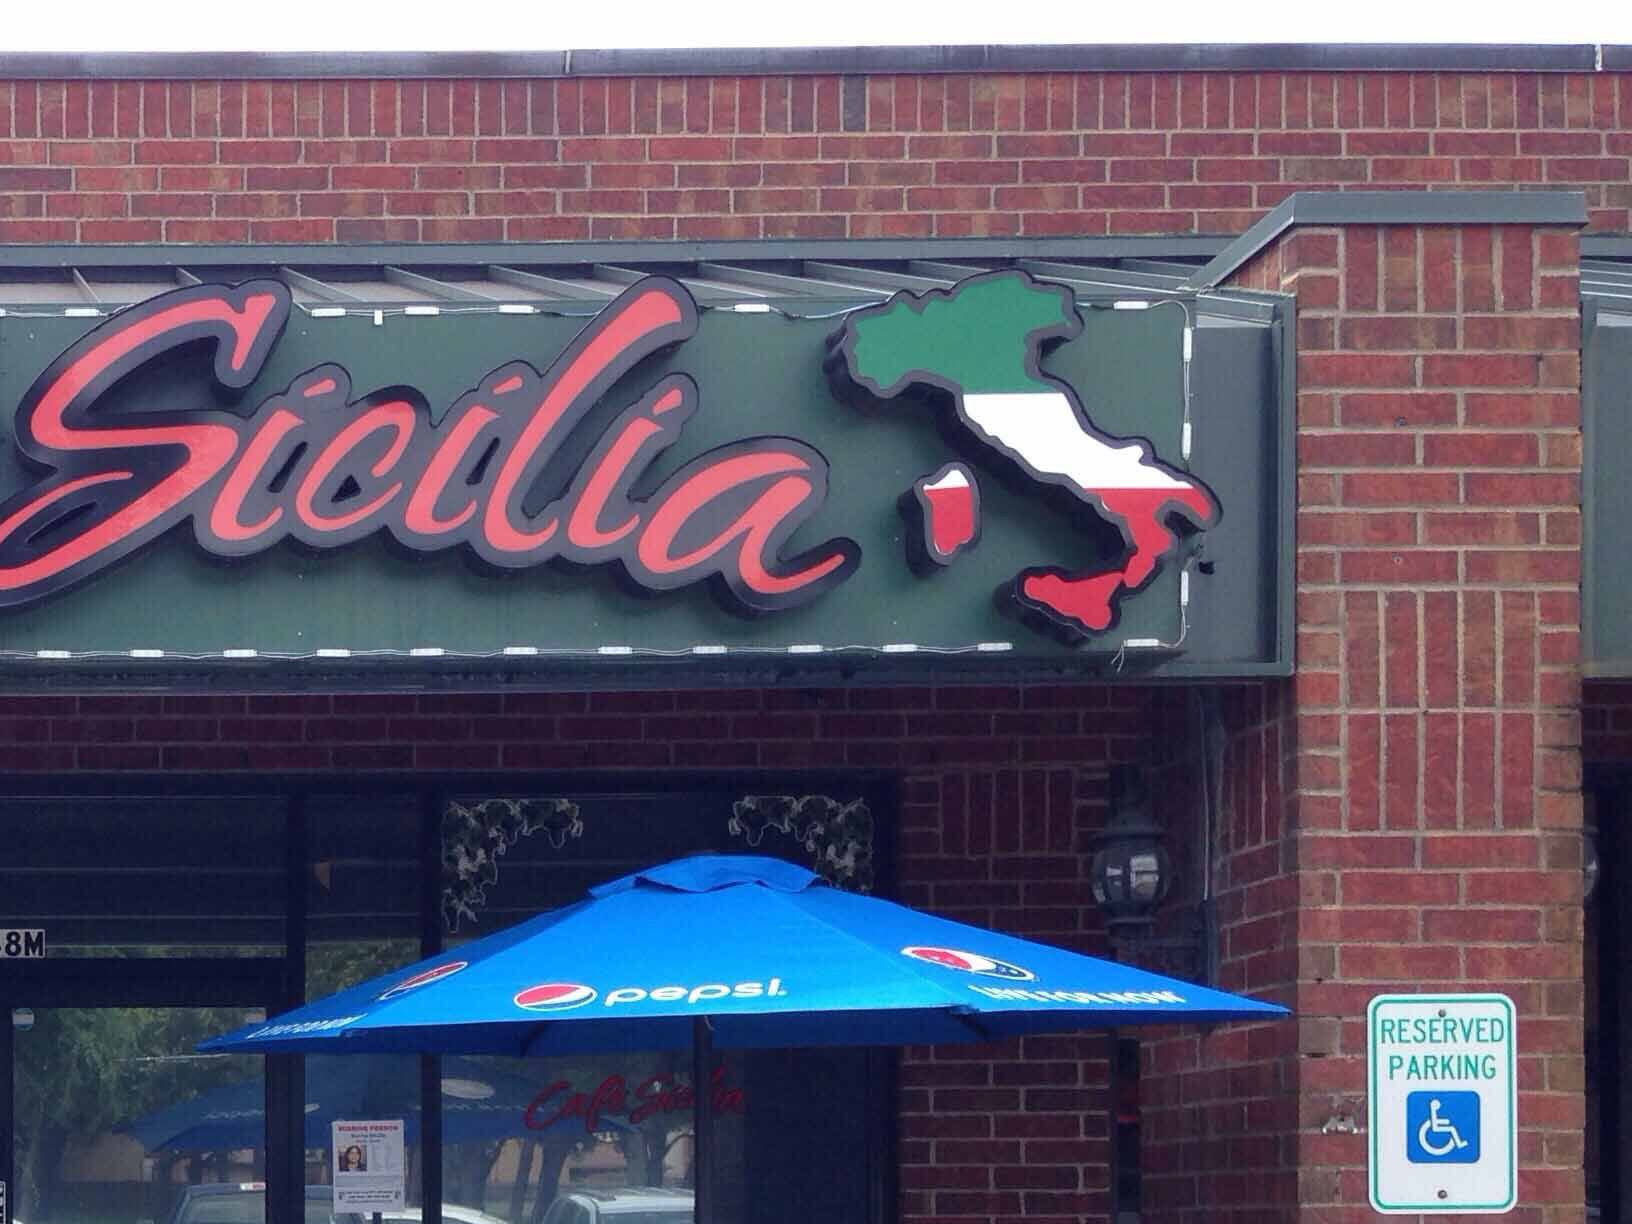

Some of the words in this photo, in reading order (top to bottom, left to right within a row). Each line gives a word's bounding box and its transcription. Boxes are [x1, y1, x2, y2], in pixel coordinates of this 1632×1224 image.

[604, 977, 786, 1008] pepsi
[1380, 1017, 1505, 1044] RESERVED
[1388, 1054, 1497, 1080] PARKING
